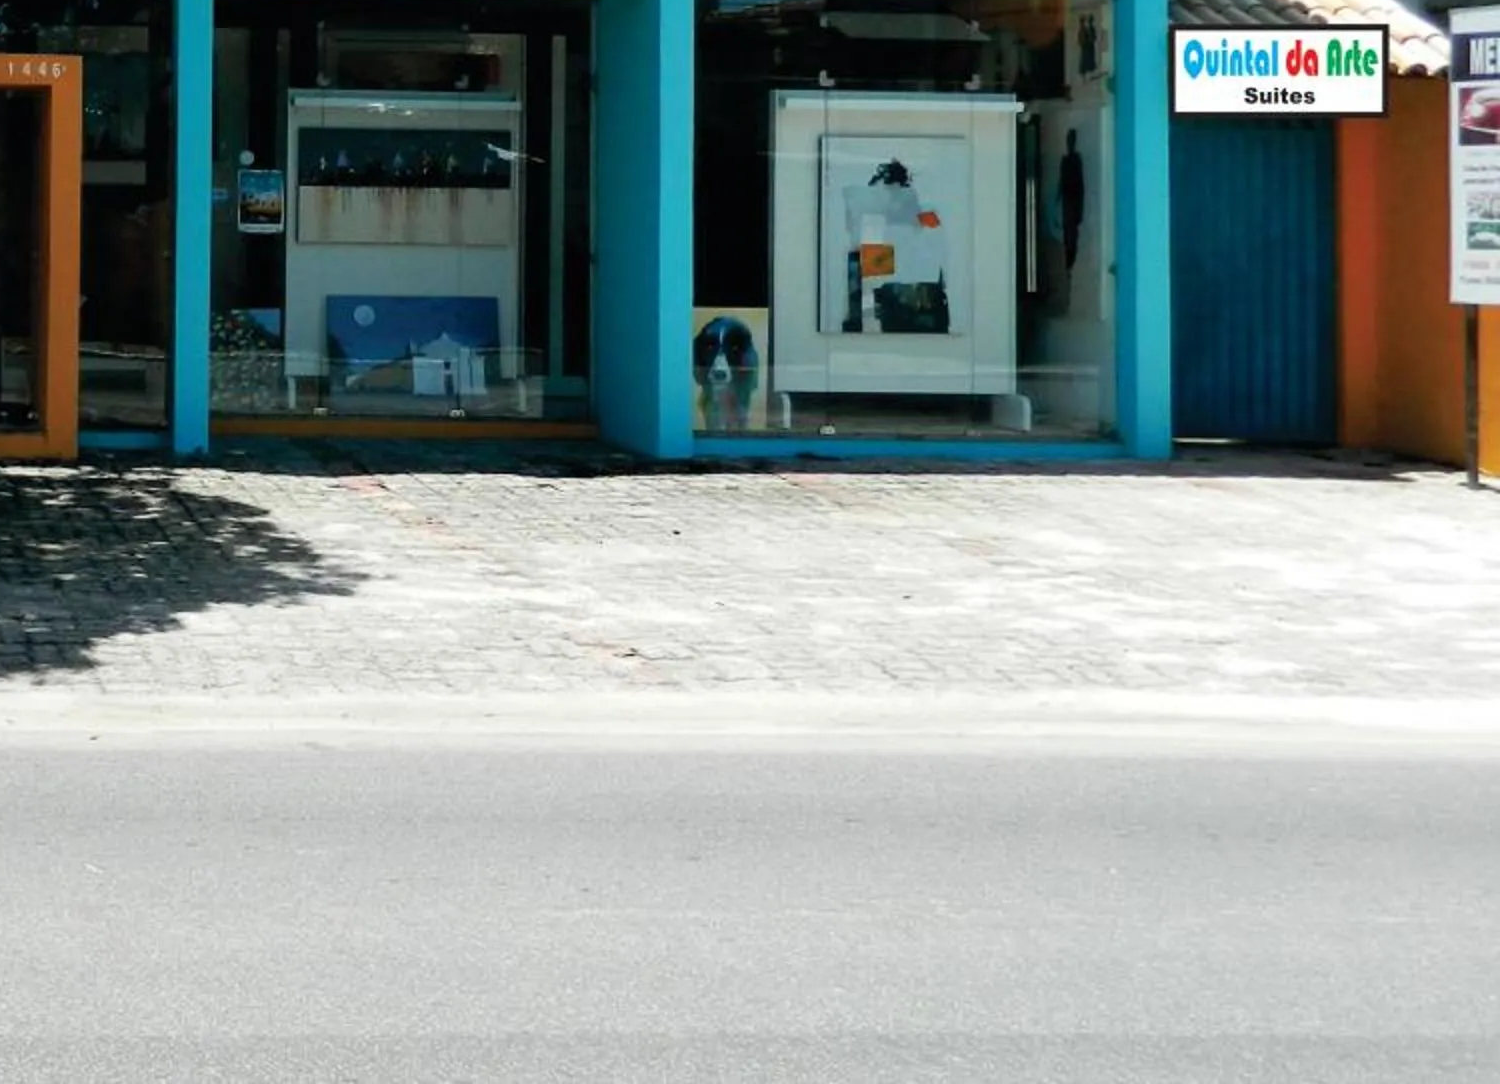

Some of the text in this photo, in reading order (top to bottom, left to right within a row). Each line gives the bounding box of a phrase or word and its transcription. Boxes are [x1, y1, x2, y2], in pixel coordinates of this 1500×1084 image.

[1183, 38, 1379, 79] Quintal da Arte
[1243, 87, 1316, 105] Suites
